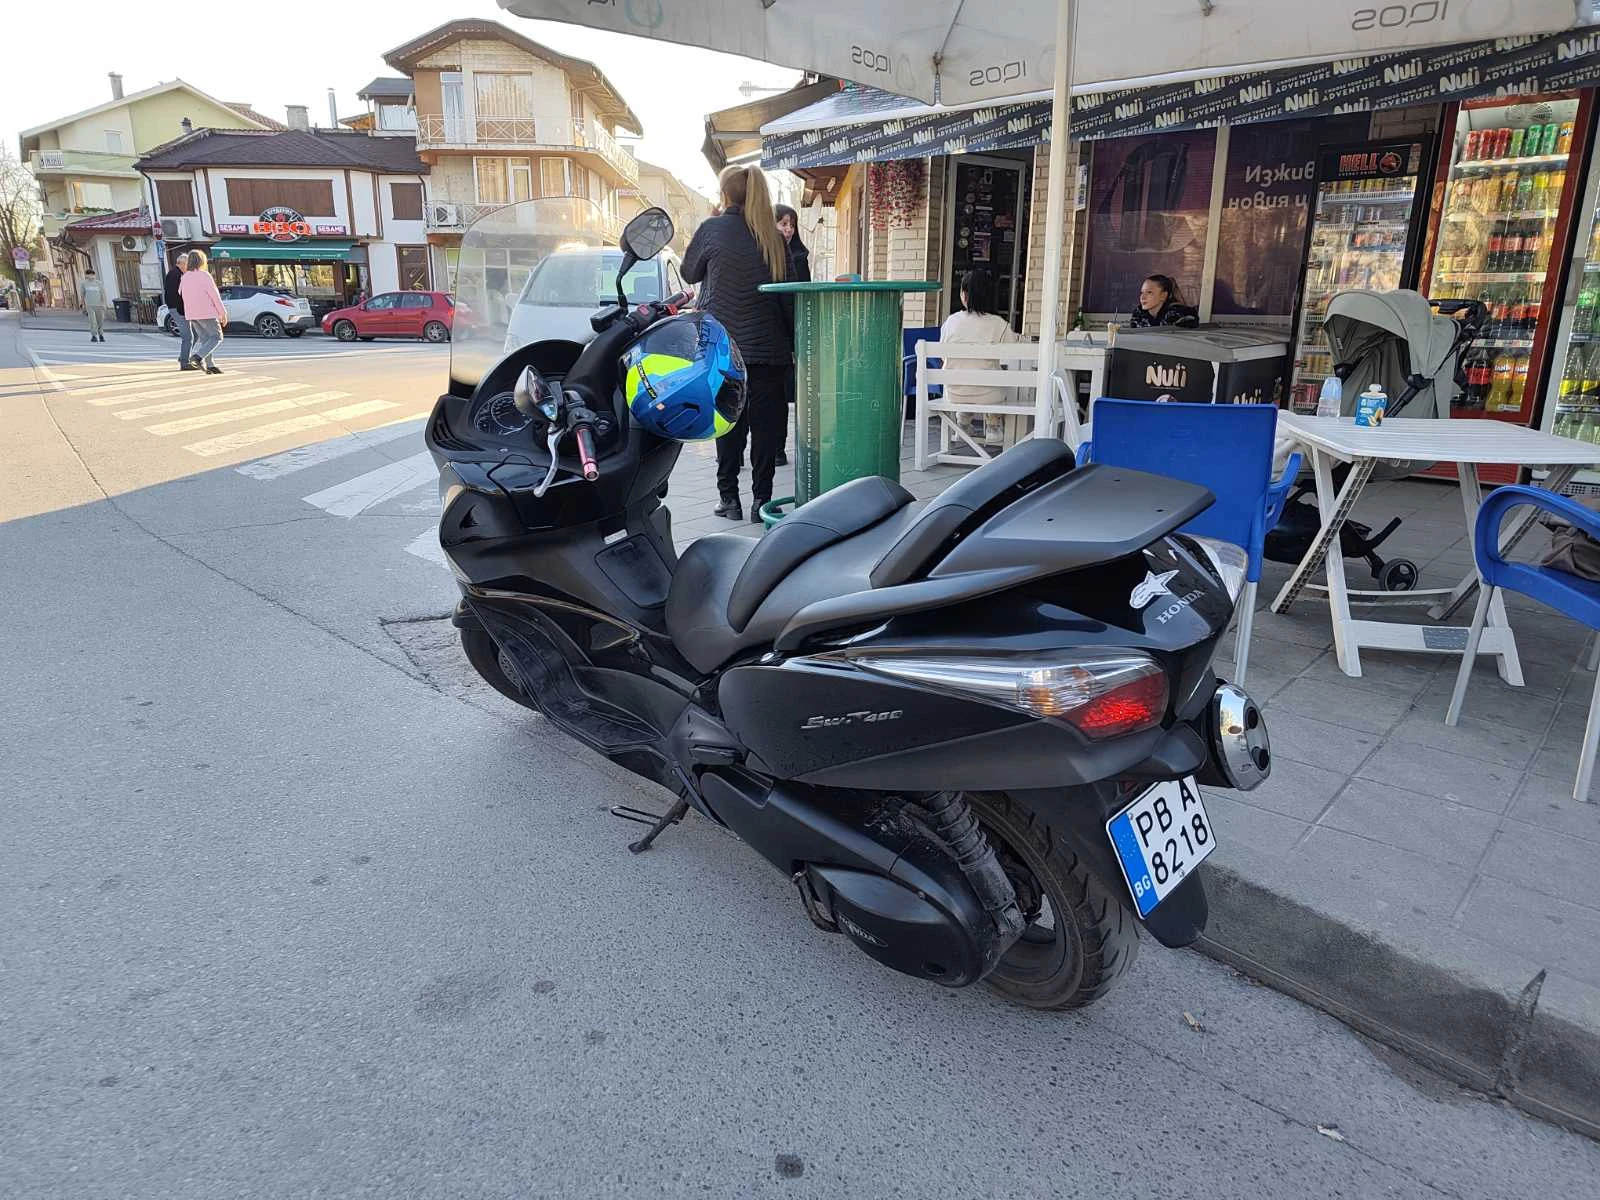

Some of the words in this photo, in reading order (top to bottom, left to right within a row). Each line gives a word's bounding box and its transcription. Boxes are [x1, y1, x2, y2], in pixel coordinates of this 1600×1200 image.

[1333, 57, 1370, 75] Nuii
[1425, 47, 1493, 73] ADVENTURE
[1484, 56, 1554, 81] ADVENTURE
[1384, 57, 1423, 83] Nuii
[1194, 77, 1225, 95] Nuii
[1275, 71, 1330, 94] ADVENTURE
[1440, 67, 1480, 93] Nuii
[1240, 80, 1272, 104] Nuii
[1284, 88, 1319, 111] Nuii
[1323, 79, 1381, 101] ADVENTURE
[1372, 89, 1436, 110] ADVENTURE
[1077, 93, 1104, 110] Nuii
[1115, 98, 1143, 120] Nuii
[1146, 91, 1193, 111] ADVENTURE
[1188, 100, 1238, 119] ADVENTURE
[973, 107, 998, 125] Nuii
[1007, 113, 1034, 133] Nuii
[1070, 116, 1113, 134] ADVENTURE
[1155, 106, 1185, 128] Nuii
[803, 128, 821, 145] Nuii
[883, 118, 905, 136] Nuii
[913, 126, 936, 145] Nuii
[937, 121, 974, 138] ADVENTURE
[830, 136, 849, 154] Nuii
[851, 133, 883, 147] ADVENTURE
[944, 134, 967, 152] Nuii
[969, 129, 1007, 146] ADVENTURE
[857, 145, 877, 161] Nuii
[1340, 153, 1378, 172] HELL
[1229, 191, 1289, 209] новия
[219, 224, 248, 232] SESAME
[253, 221, 312, 236] BBQ
[317, 225, 345, 233] SESAME
[1145, 361, 1187, 387] Nuii
[1155, 588, 1205, 624] HONDA
[1136, 797, 1173, 849] PB
[1178, 778, 1196, 812] A
[1151, 813, 1209, 885] 8218
[1133, 874, 1151, 898] BG
